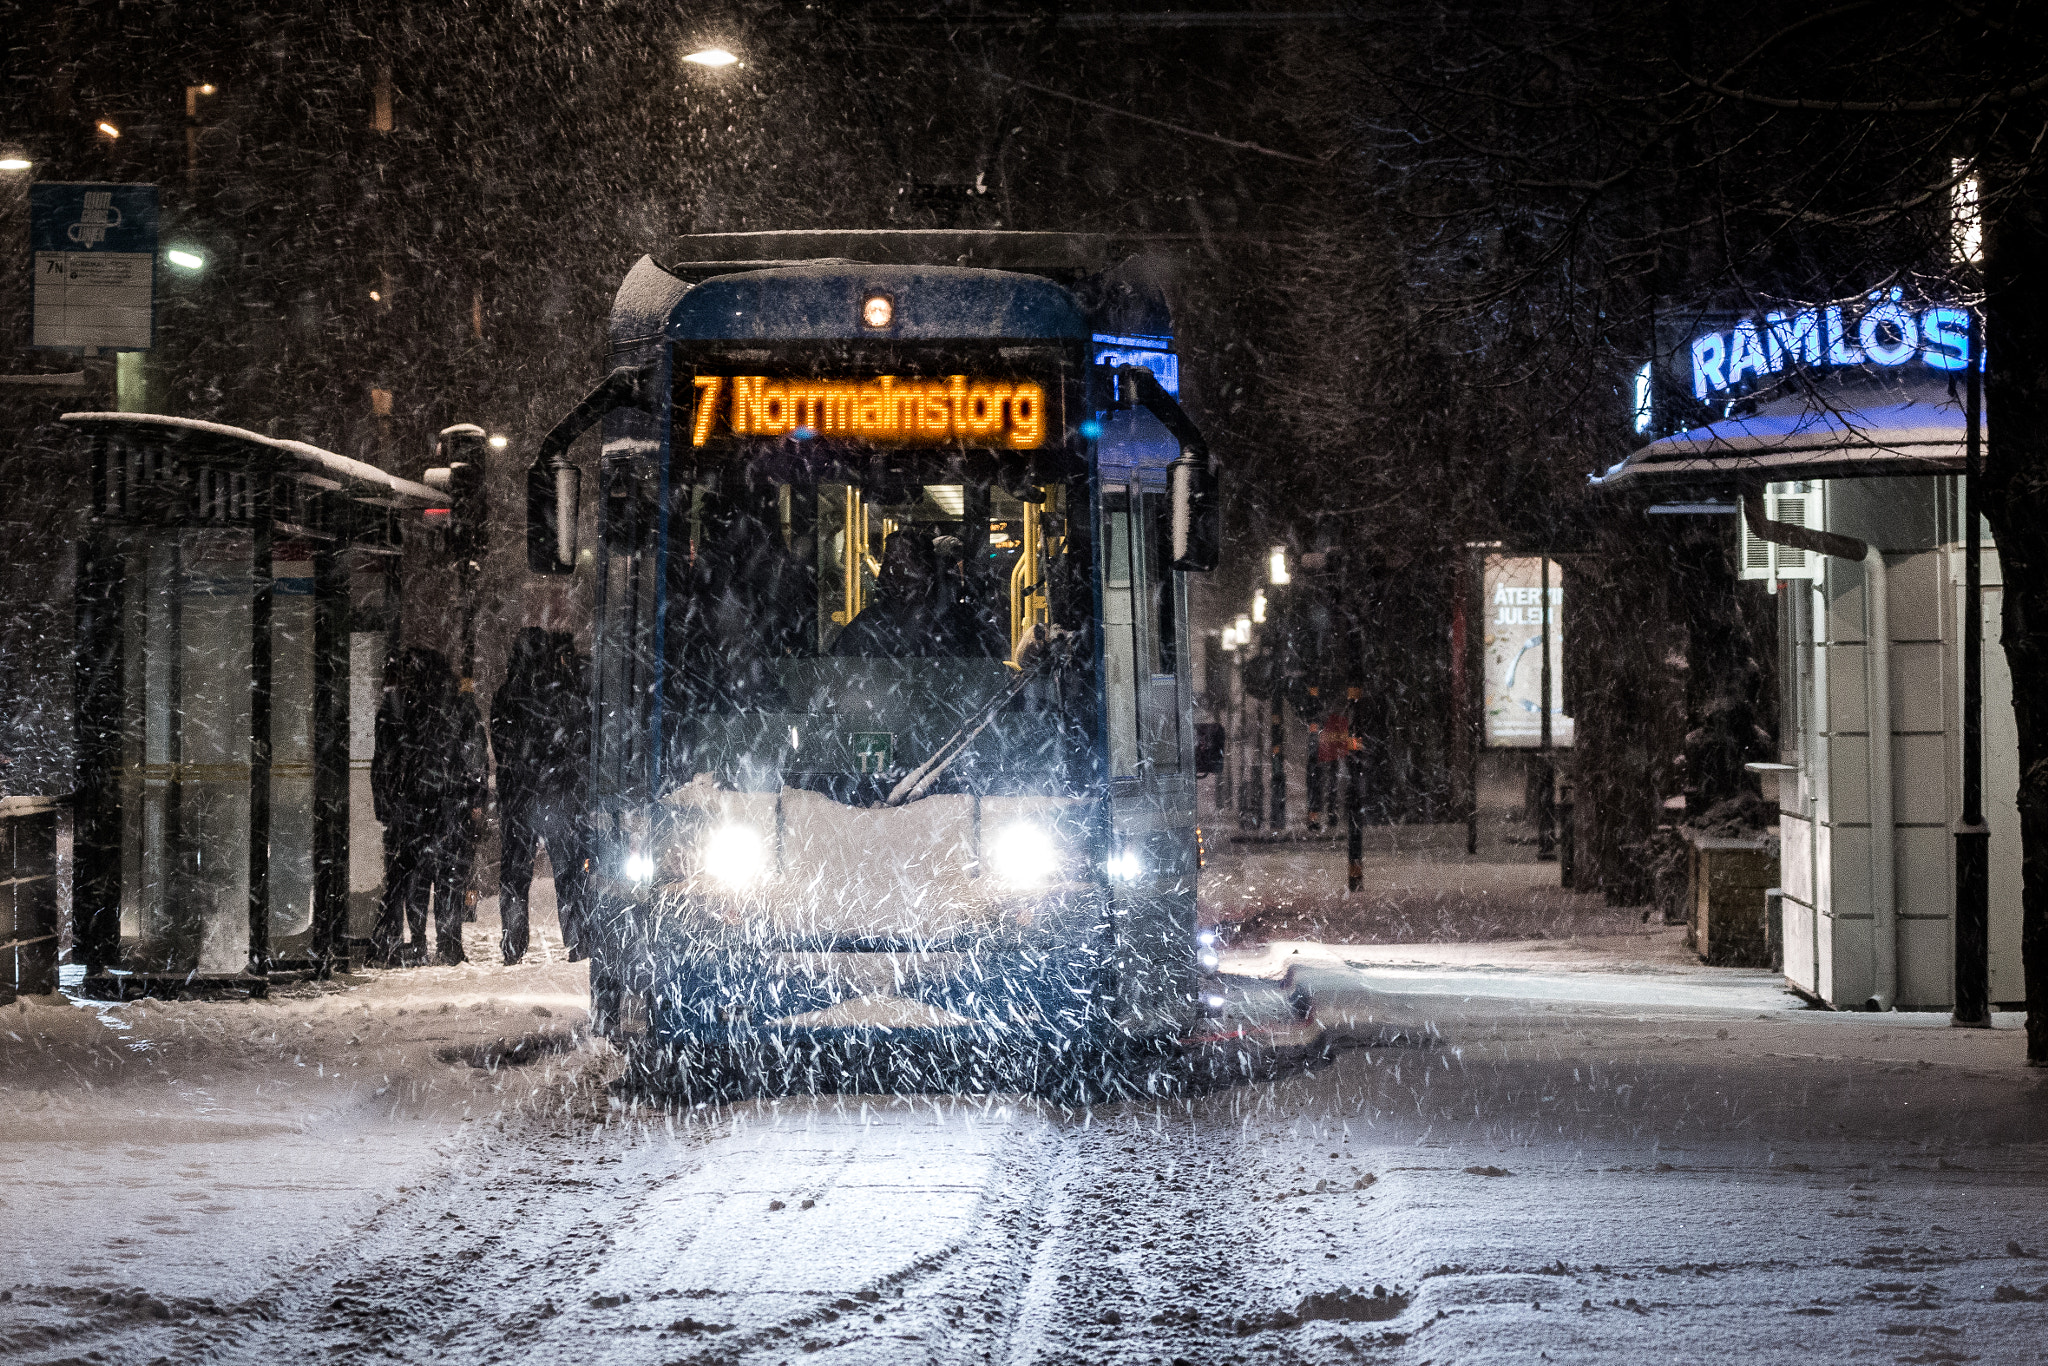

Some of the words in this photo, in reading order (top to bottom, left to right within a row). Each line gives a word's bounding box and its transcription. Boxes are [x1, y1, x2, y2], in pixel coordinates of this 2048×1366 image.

[1692, 286, 1987, 400] RAMLÖS
[693, 375, 718, 446] 7
[736, 375, 1039, 444] Norrmalmstorg
